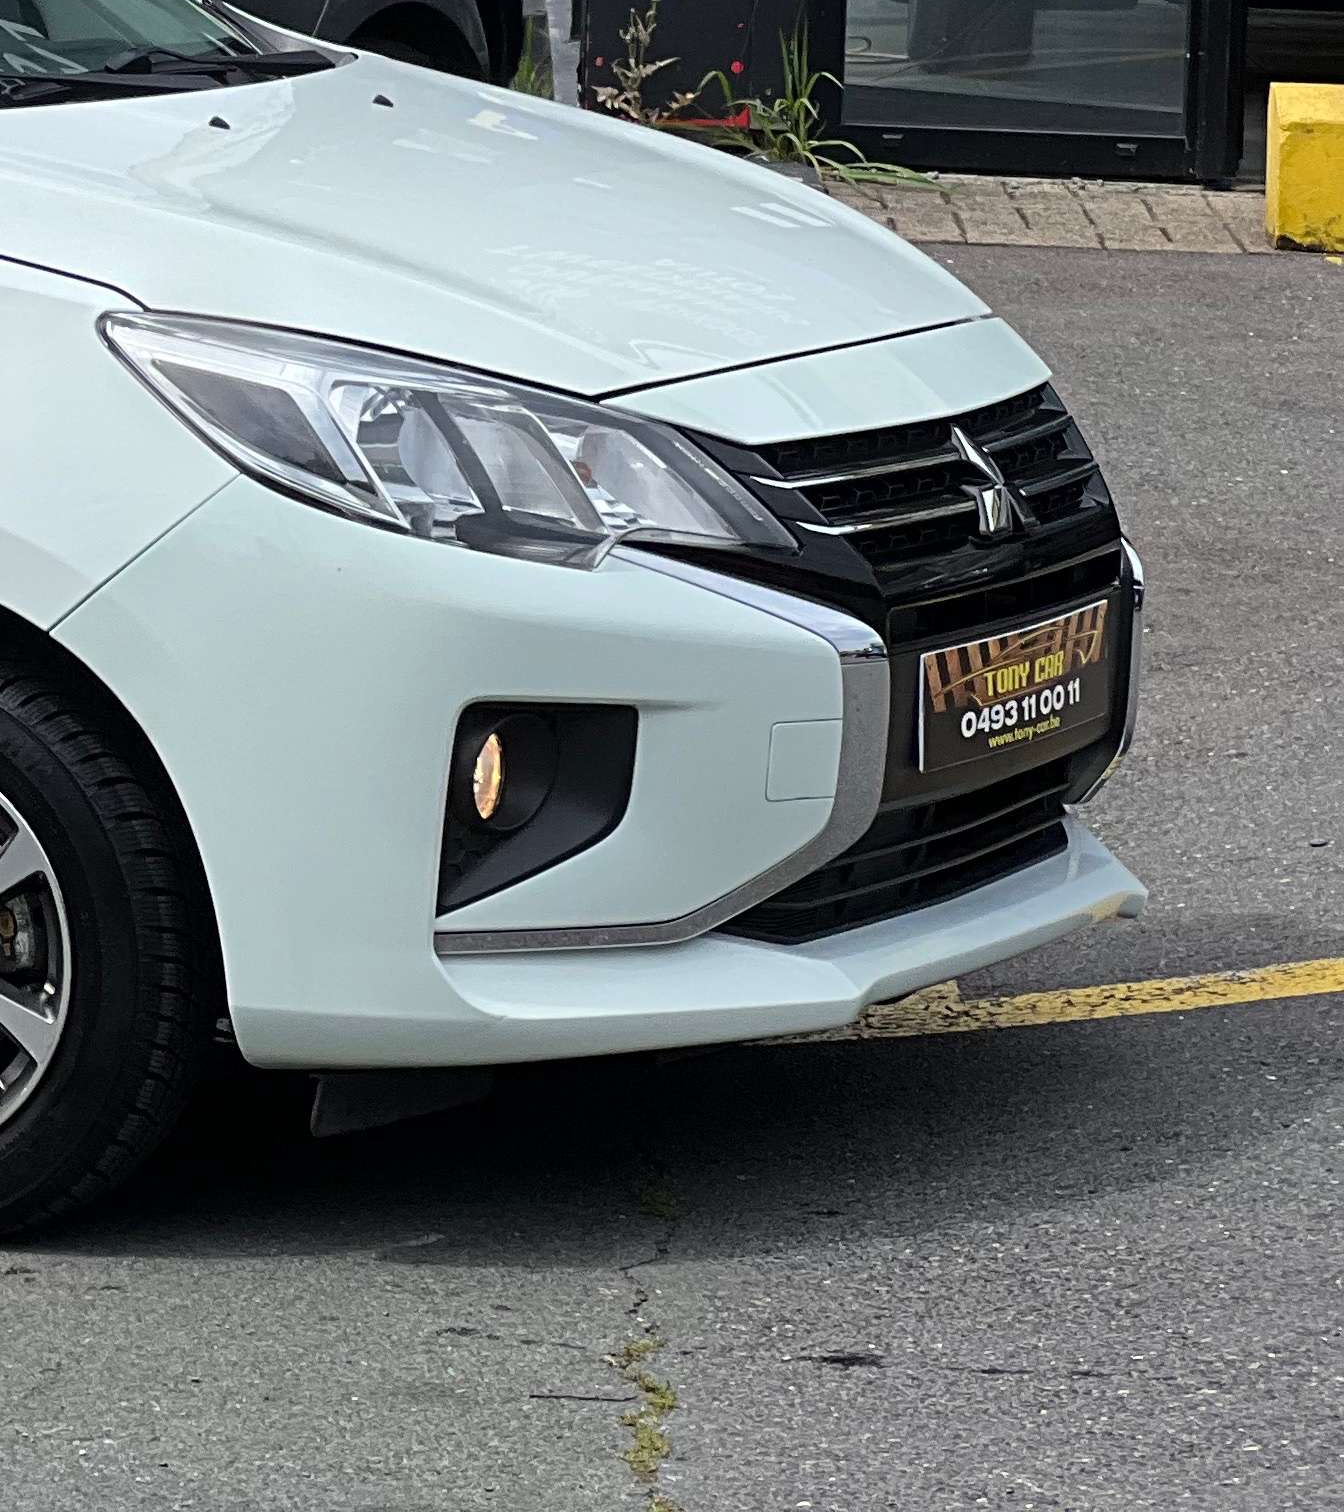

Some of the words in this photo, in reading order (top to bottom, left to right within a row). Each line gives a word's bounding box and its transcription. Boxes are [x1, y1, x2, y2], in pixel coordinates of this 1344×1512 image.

[984, 661, 1031, 697] TONY
[1035, 650, 1064, 684] CAR
[961, 700, 1019, 738] 0493
[1021, 694, 1037, 721] 11
[1040, 685, 1065, 715] 00
[1067, 677, 1080, 705] 11
[988, 713, 1061, 748] www.tony-car.be
